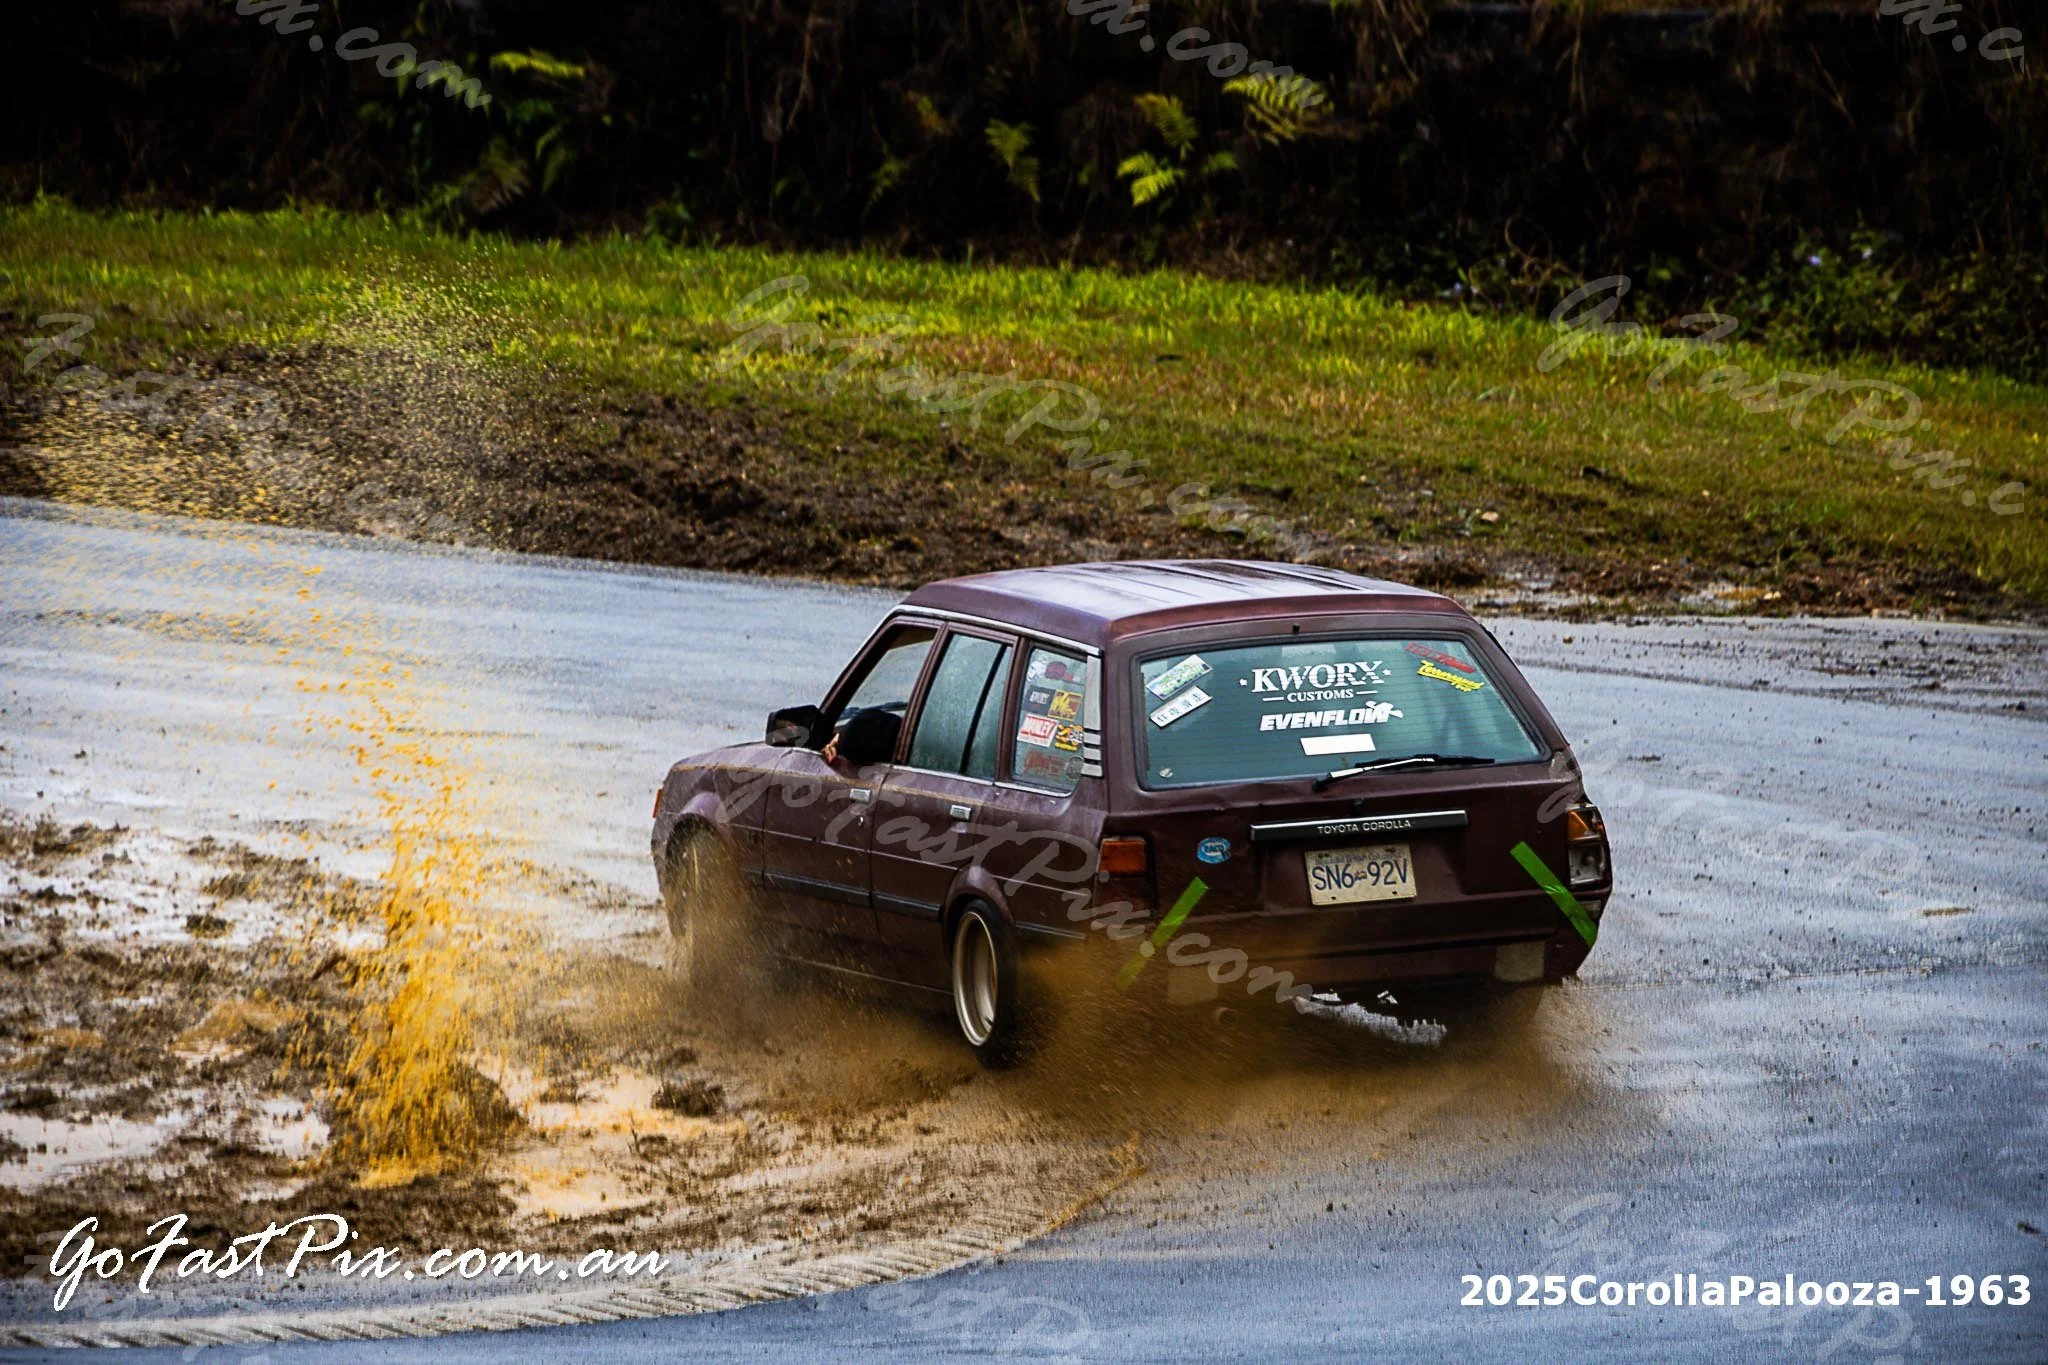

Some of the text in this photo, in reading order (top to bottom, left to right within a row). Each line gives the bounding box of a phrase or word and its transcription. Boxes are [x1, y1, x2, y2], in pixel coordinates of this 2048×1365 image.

[1251, 660, 1385, 693] KWORX
[1286, 688, 1354, 703] CUSTOMS
[1259, 702, 1394, 732] EVENFLOW
[1317, 819, 1412, 834] TOYOTA COROLLA
